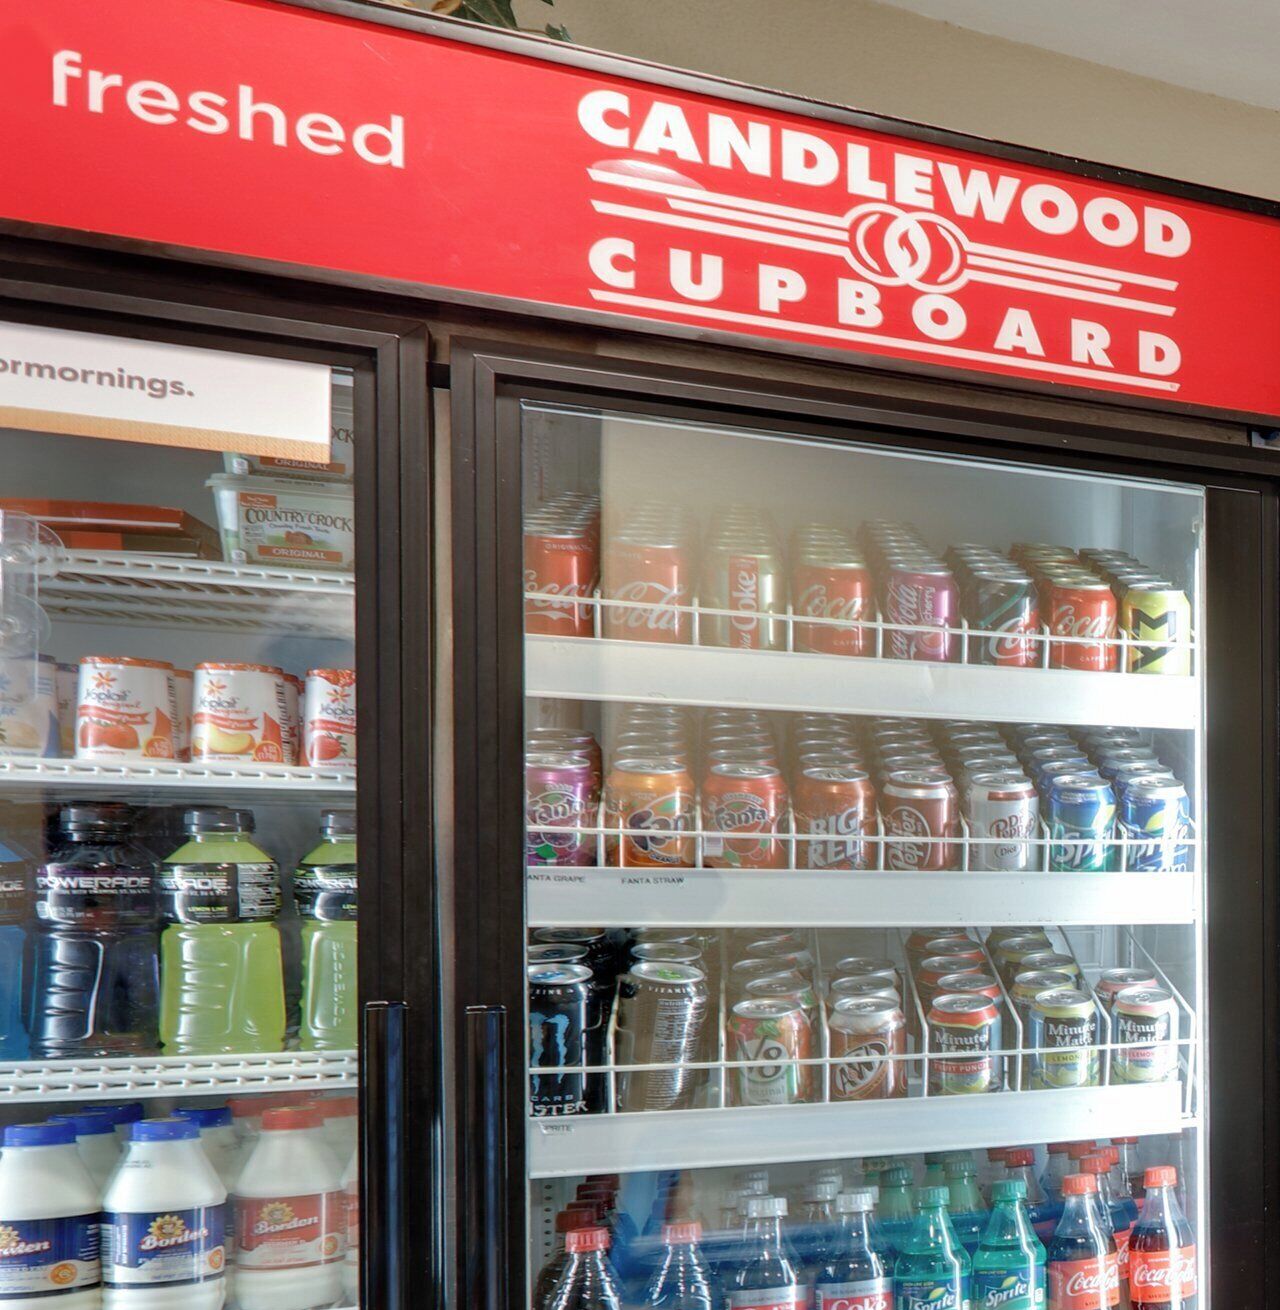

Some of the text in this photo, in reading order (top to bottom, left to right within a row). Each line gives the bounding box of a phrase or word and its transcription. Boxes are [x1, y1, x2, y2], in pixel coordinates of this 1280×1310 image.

[52, 49, 406, 169] freshed
[577, 88, 1193, 260] CANDLEWOOD
[589, 236, 1184, 377] CUPBOARD
[245, 508, 305, 524] COUNTRY
[307, 512, 354, 532] CROCK
[272, 549, 327, 560] ORIGINAL
[714, 806, 769, 832] Fanta
[809, 807, 860, 837] BIG
[806, 838, 862, 869] RED
[37, 876, 151, 890] POWERADE
[621, 876, 685, 885] FANTA STRAW
[935, 1028, 988, 1047] Minute
[1048, 1021, 1096, 1038] Minute
[1118, 1018, 1167, 1035] Minute
[1125, 1031, 1165, 1045] Maid
[1055, 1033, 1093, 1047] Maid
[735, 1034, 783, 1080] V8
[253, 1214, 319, 1235] Borden
[139, 1227, 209, 1251] Borden
[985, 1283, 1028, 1308] Sprite
